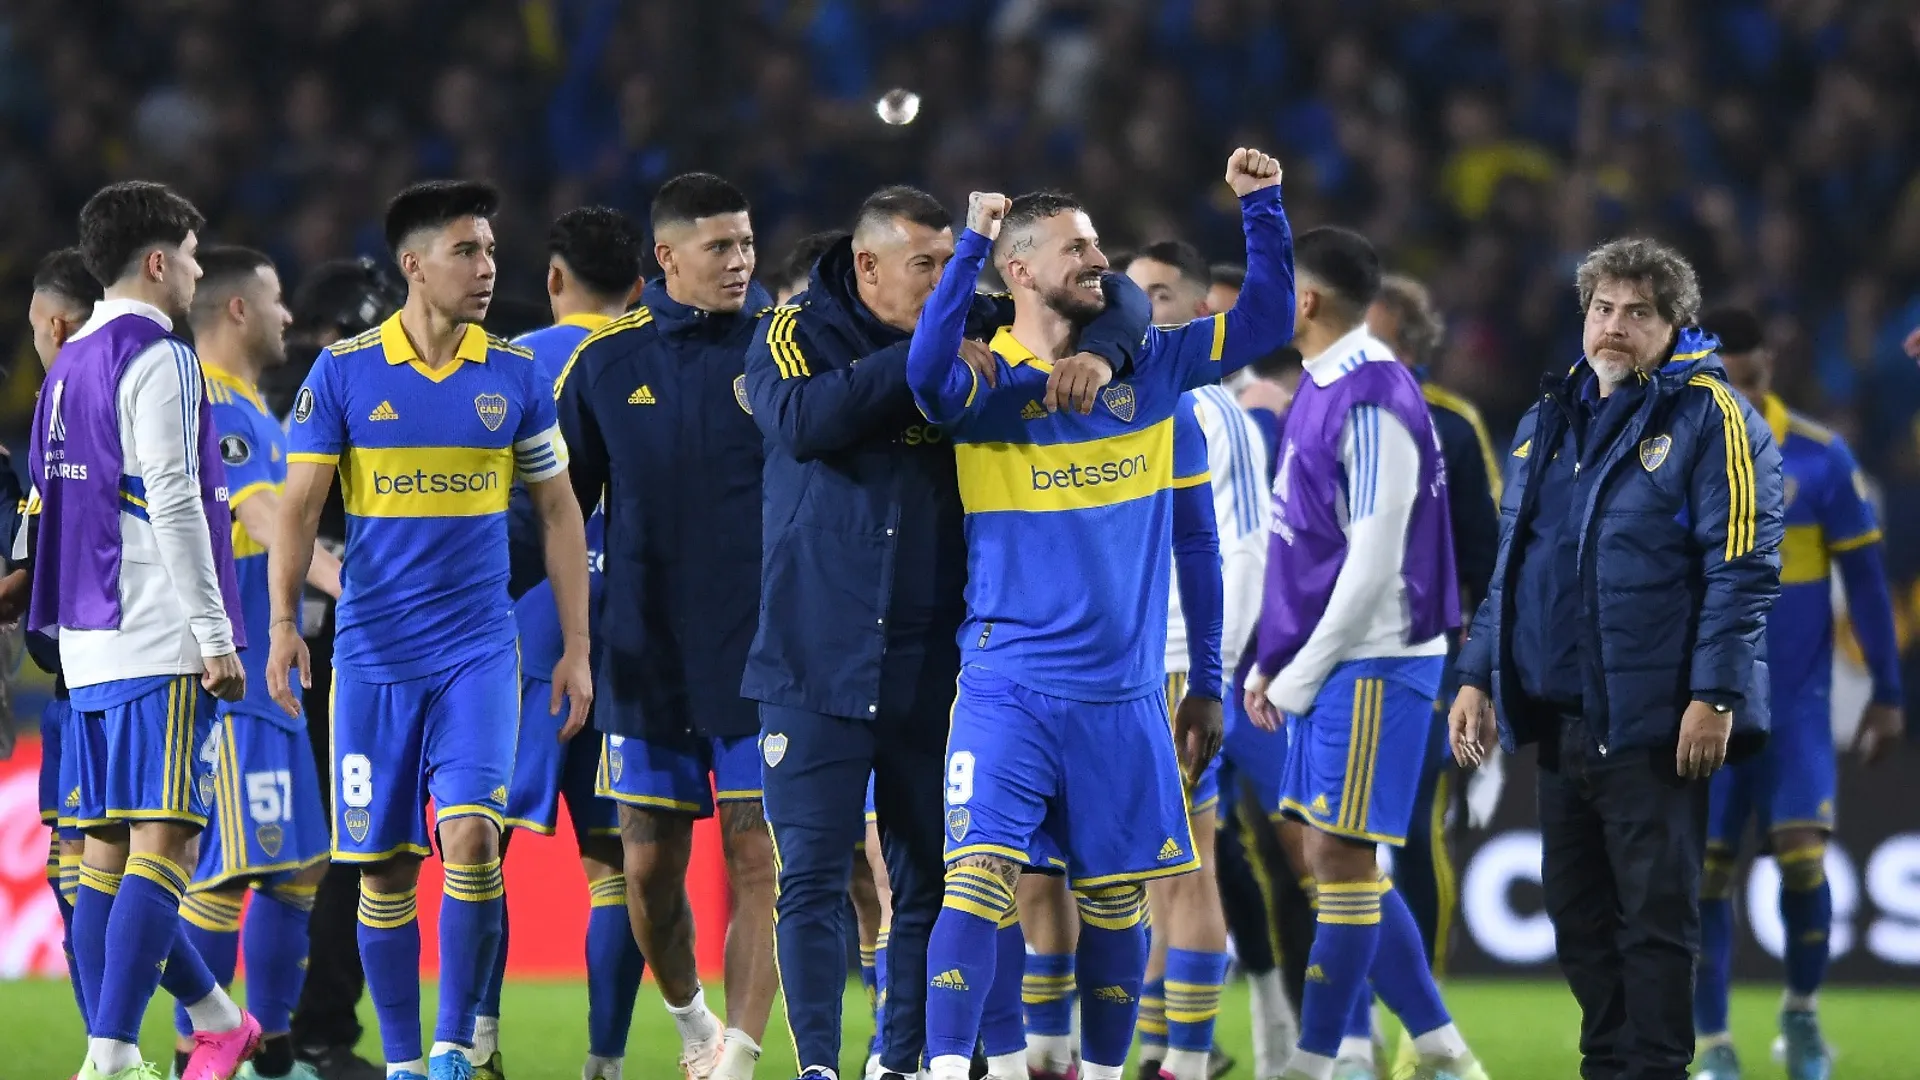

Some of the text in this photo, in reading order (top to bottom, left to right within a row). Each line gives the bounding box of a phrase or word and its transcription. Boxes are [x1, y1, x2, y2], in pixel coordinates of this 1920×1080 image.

[373, 469, 497, 494] betsson
[1030, 454, 1147, 491] betsson
[342, 754, 373, 807] 8
[947, 751, 975, 805] 9
